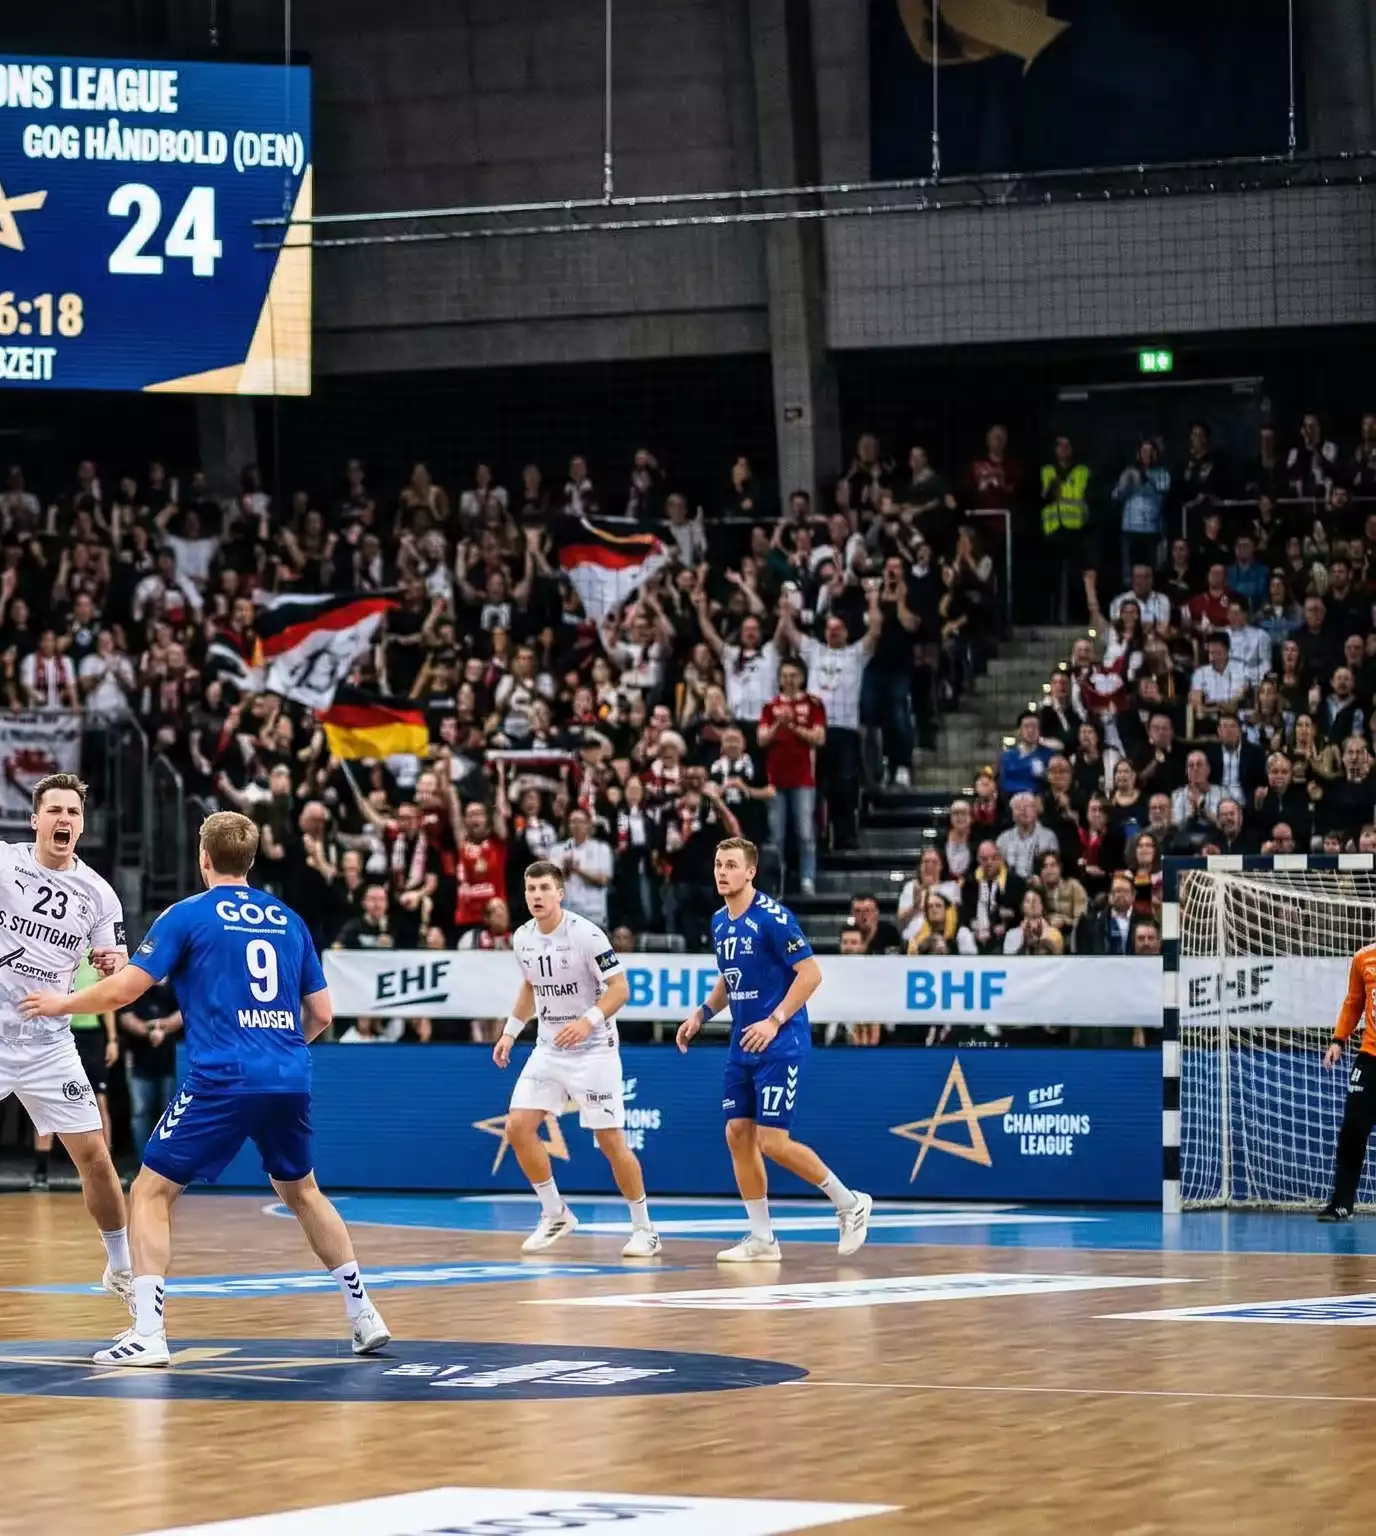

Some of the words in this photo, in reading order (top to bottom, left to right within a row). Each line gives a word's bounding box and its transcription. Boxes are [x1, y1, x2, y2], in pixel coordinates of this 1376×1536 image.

[60, 66, 178, 113] LEAGUE
[23, 124, 79, 159] GOG
[84, 119, 228, 164] HÅNDBOLD
[233, 131, 305, 174] (DEN)
[106, 182, 223, 277] 24
[32, 885, 69, 920] 23
[216, 900, 288, 926] GOG
[9, 915, 82, 951] STUTTGART
[723, 937, 738, 960] 17
[15, 962, 58, 979] PORTNES
[245, 938, 278, 1003] 9
[376, 960, 451, 1001] EHF
[538, 955, 553, 977] 11
[625, 967, 719, 1007] BHF
[906, 970, 1007, 1011] BHF
[1189, 965, 1274, 1008] EHF
[237, 1009, 295, 1031] MADSEN
[762, 1086, 784, 1111] 17
[1028, 1083, 1064, 1104] EHF
[1004, 1113, 1091, 1134] CHAMPIONS
[1020, 1135, 1073, 1155] LEAGUE
